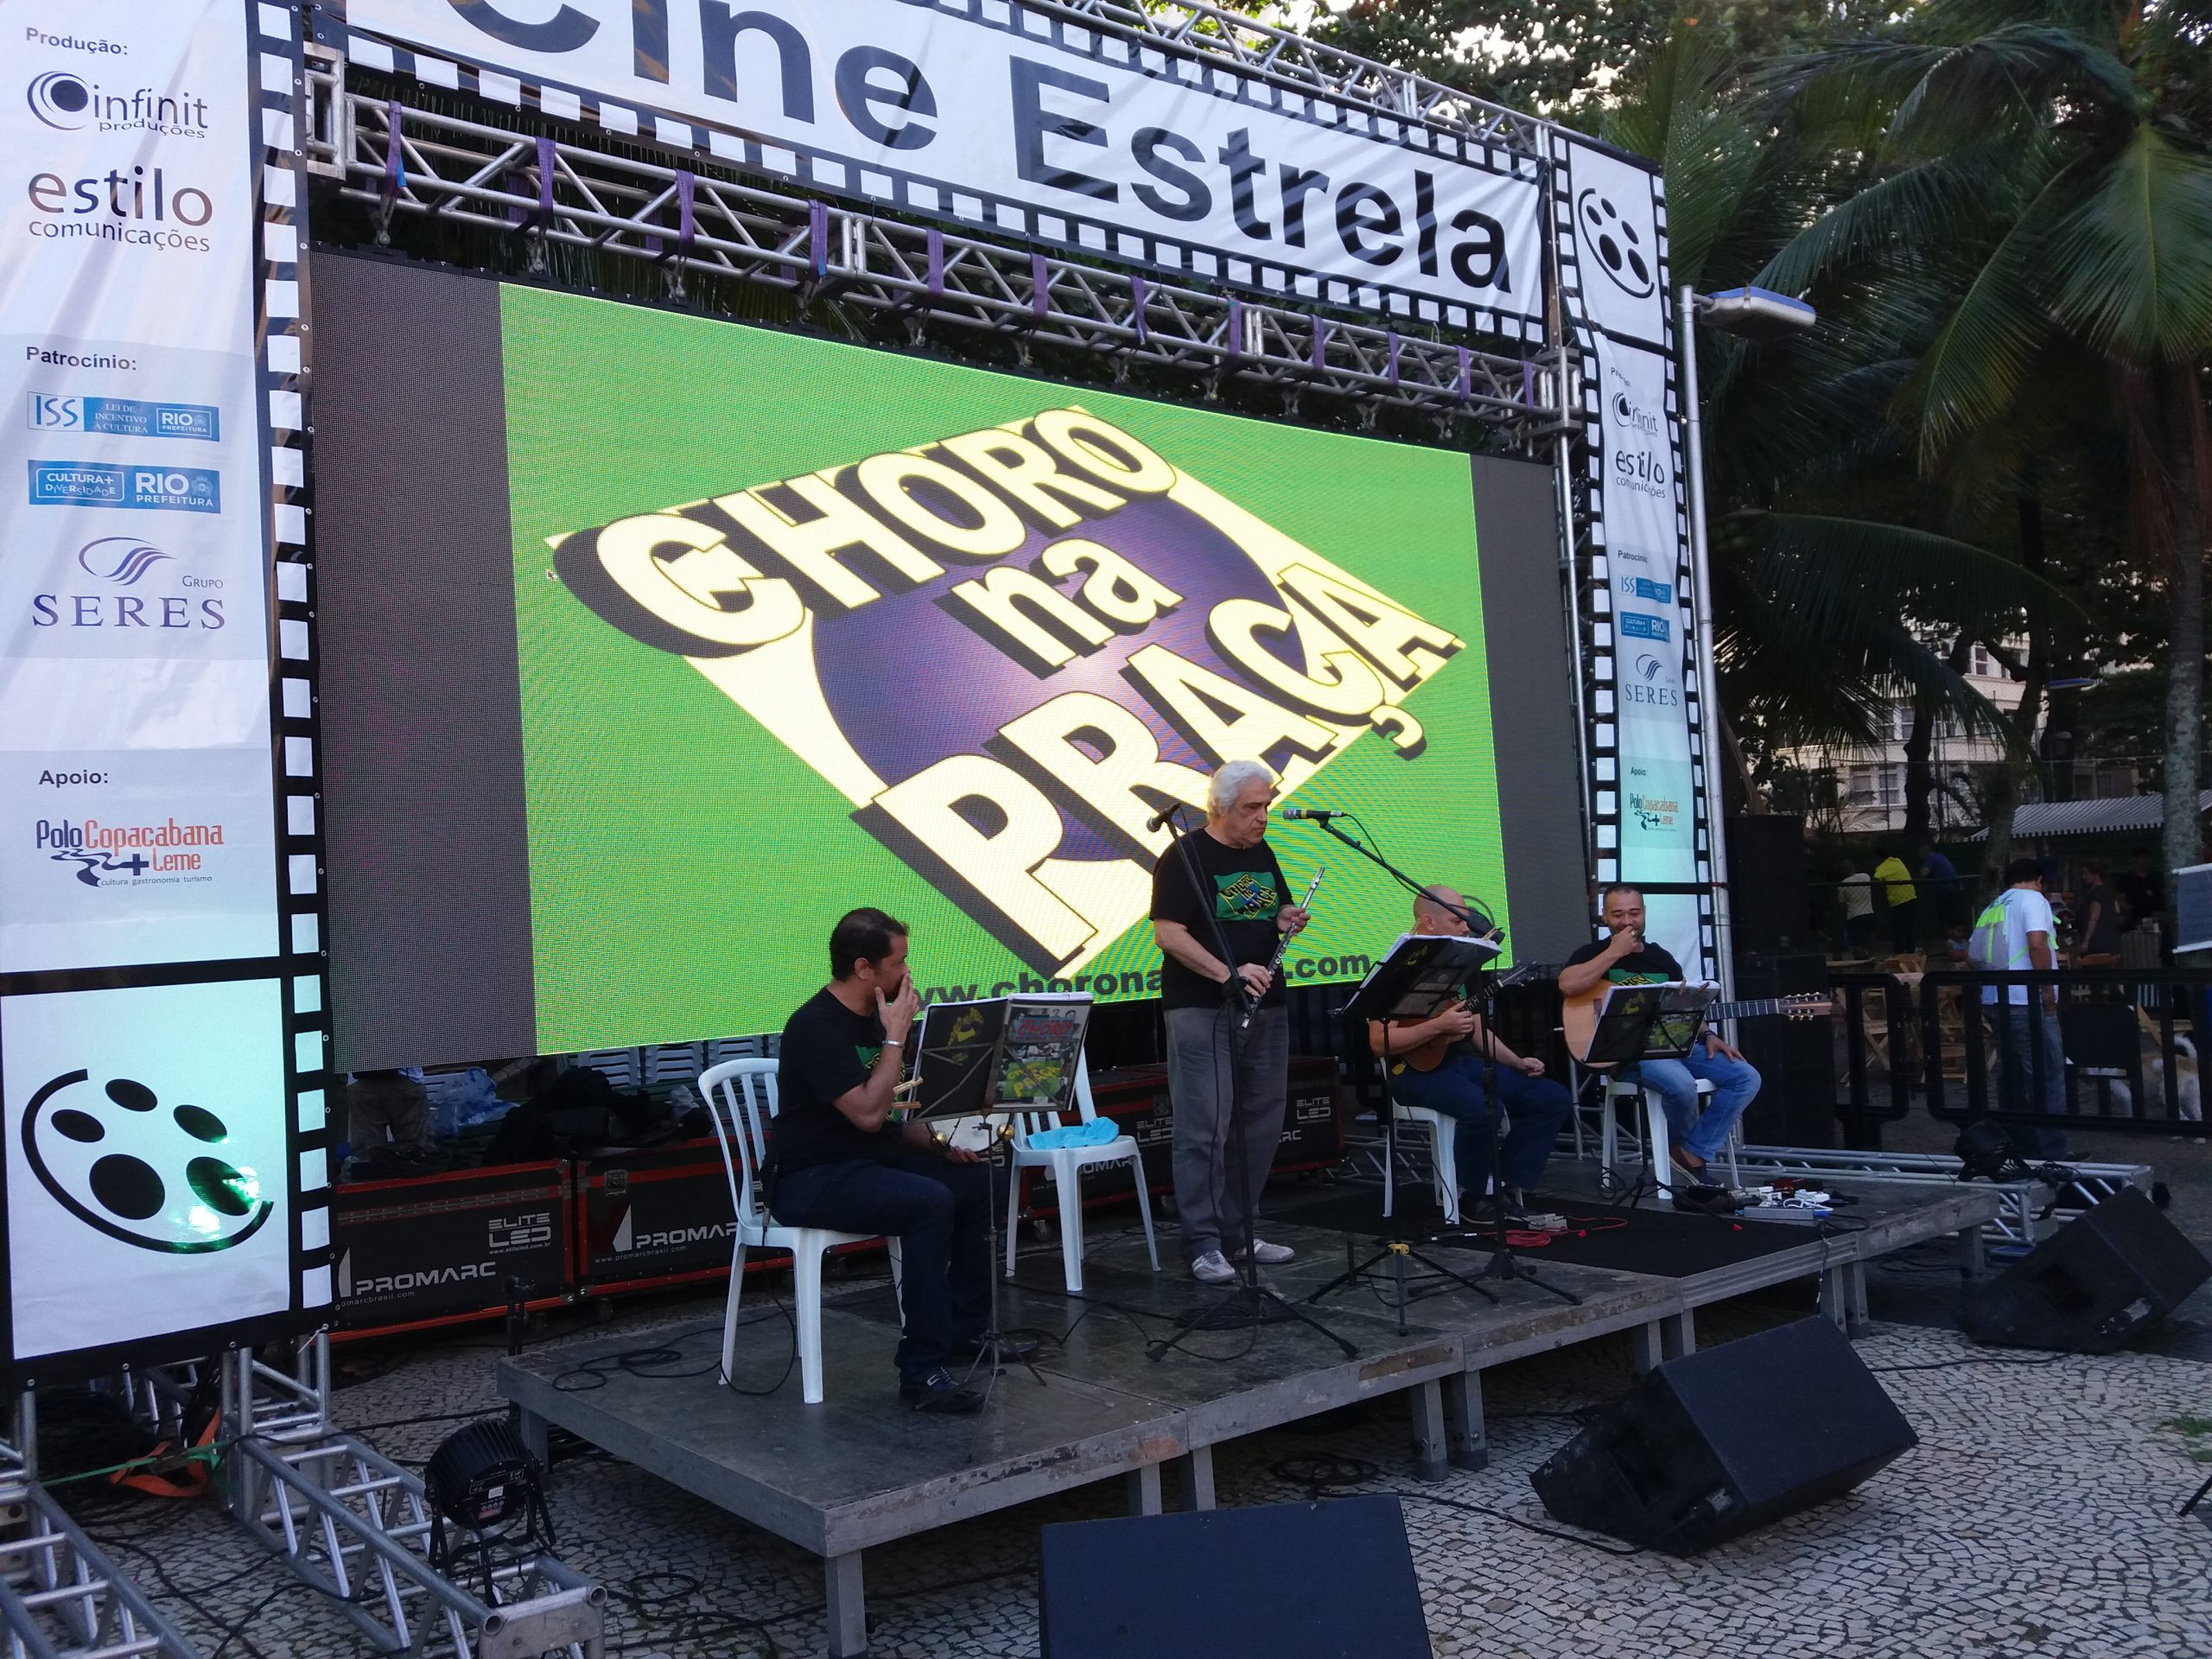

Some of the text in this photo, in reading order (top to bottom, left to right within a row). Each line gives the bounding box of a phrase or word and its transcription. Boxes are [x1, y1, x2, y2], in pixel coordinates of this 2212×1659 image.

[26, 27, 128, 55] Produção:
[93, 85, 208, 129] infinit
[99, 118, 206, 139] produções
[1009, 54, 1511, 294] Estrela
[28, 165, 213, 226] estilo
[29, 220, 210, 251] comunicações
[26, 346, 137, 371] Patrocínio:
[35, 395, 79, 428] ISS
[95, 412, 147, 423] INCENTIVO
[105, 403, 136, 413] LEI DE
[162, 412, 193, 426] RIO
[102, 423, 148, 434] CULTURA
[162, 424, 207, 433] PREFEITURA
[1616, 449, 1665, 485] estilo
[135, 472, 189, 495] RIO
[136, 495, 214, 508] PREFEITURA
[596, 408, 1177, 646] CHORO
[1621, 576, 1635, 594] ISS
[32, 594, 226, 630] SERES
[950, 538, 1185, 669] na
[1651, 619, 1665, 632] RIO
[1625, 683, 1678, 707] SERES
[39, 769, 109, 788] Apoio:
[152, 848, 201, 871] Leme
[132, 876, 180, 886] gastronomia
[183, 874, 213, 883] turismo
[1296, 1096, 1330, 1107] ELITE
[1297, 1107, 1332, 1120] LED
[488, 1212, 550, 1230] ELITE
[488, 1226, 551, 1248] LED
[594, 1244, 687, 1263] www.promarcbrasil.com
[356, 1262, 497, 1295] PROMARC
